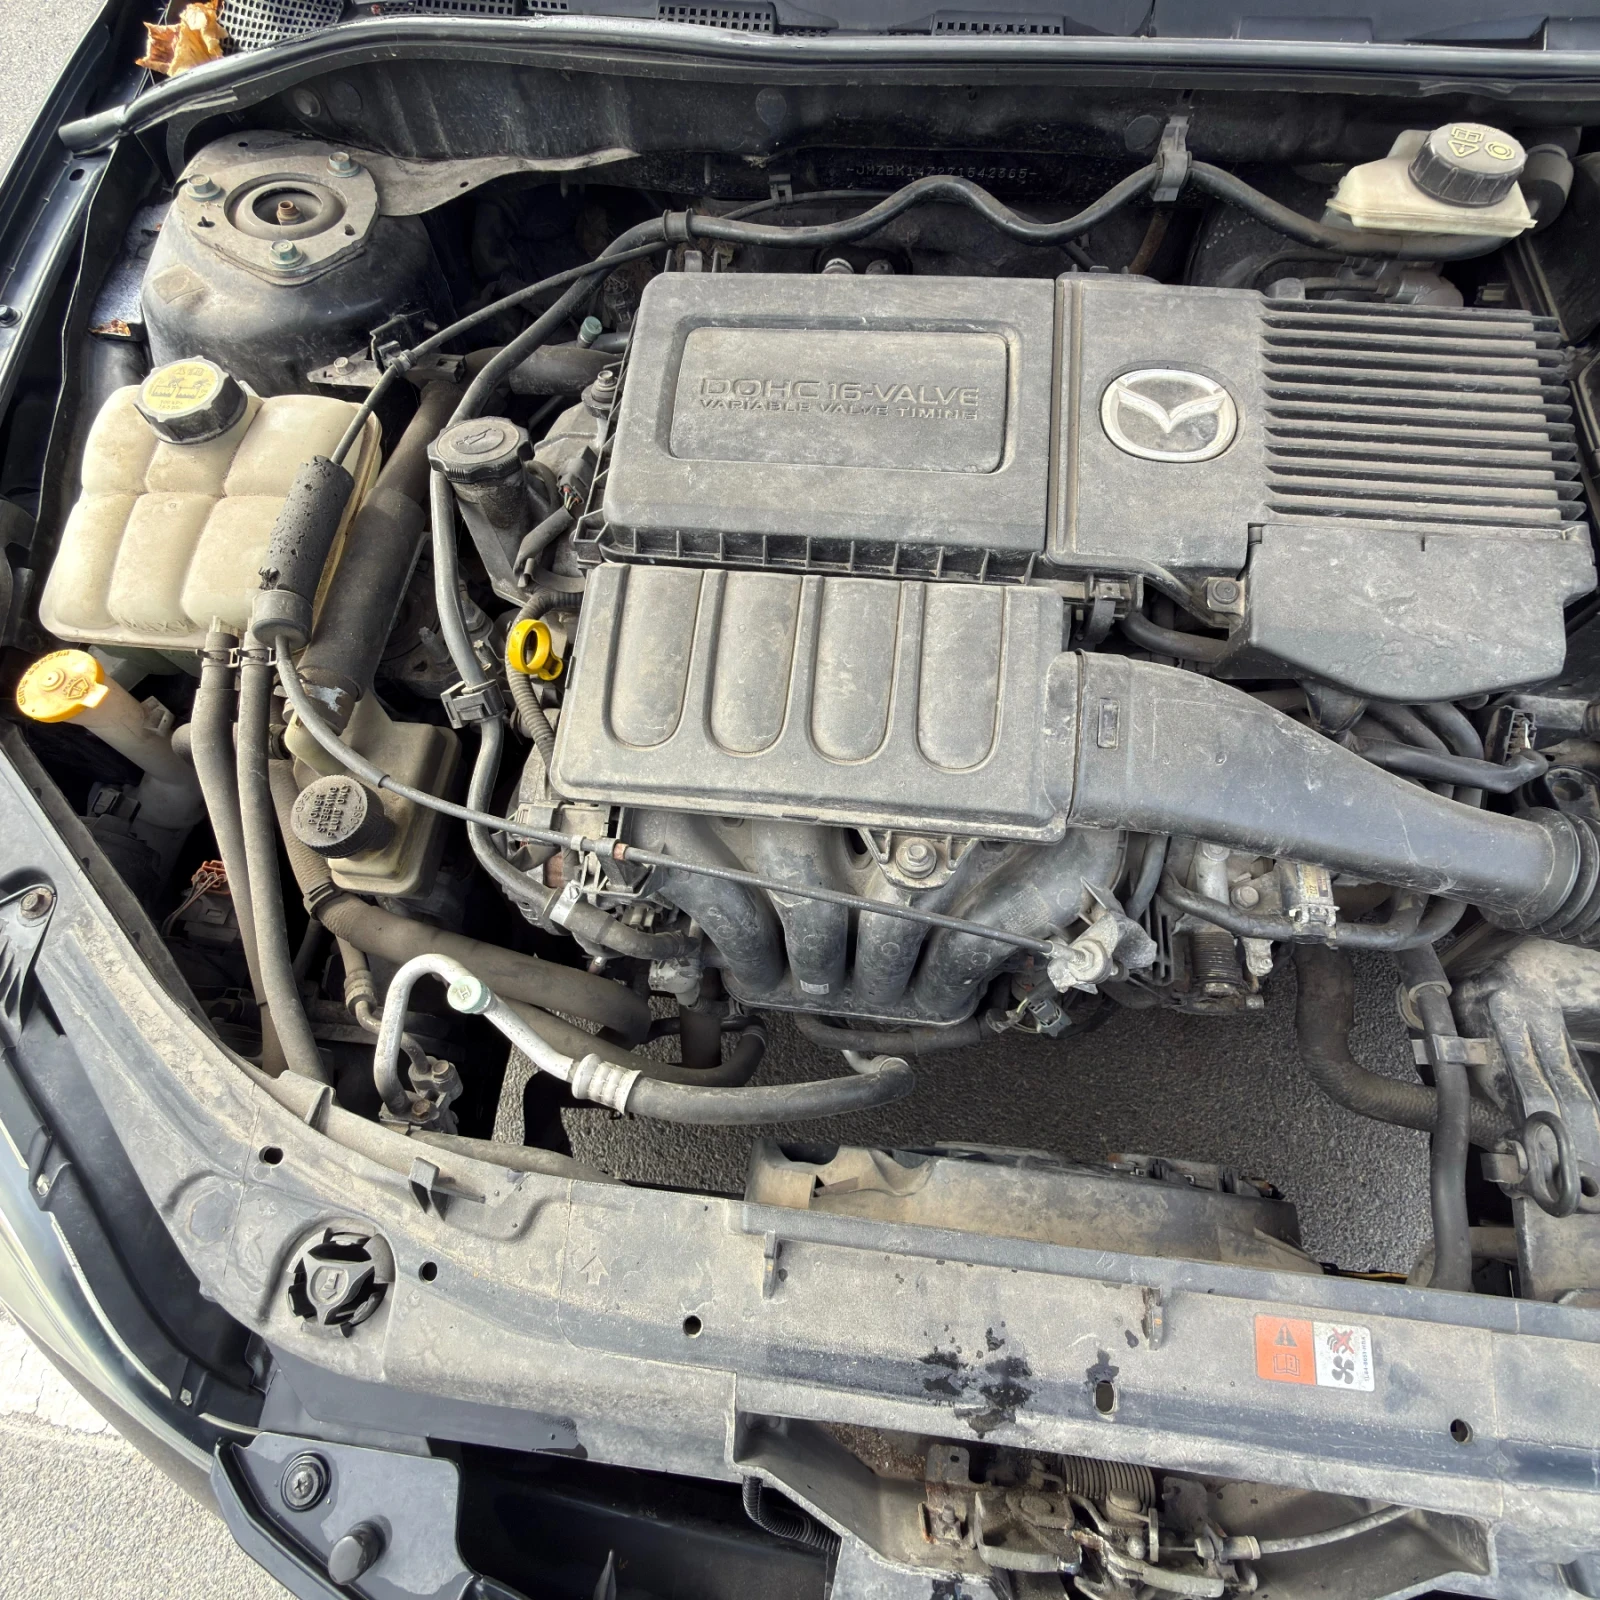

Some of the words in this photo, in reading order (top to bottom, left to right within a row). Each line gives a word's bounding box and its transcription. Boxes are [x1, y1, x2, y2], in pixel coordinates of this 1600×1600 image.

[700, 378, 820, 399] DOHC
[827, 382, 979, 406] 16-VALVE
[700, 400, 810, 412] VARIABLE
[820, 402, 889, 416] VALVE
[896, 406, 978, 420] TIMING
[308, 794, 326, 825] POWER
[317, 787, 339, 833] STEERING
[327, 809, 344, 839] FLUID
[340, 805, 364, 836] CLOSE
